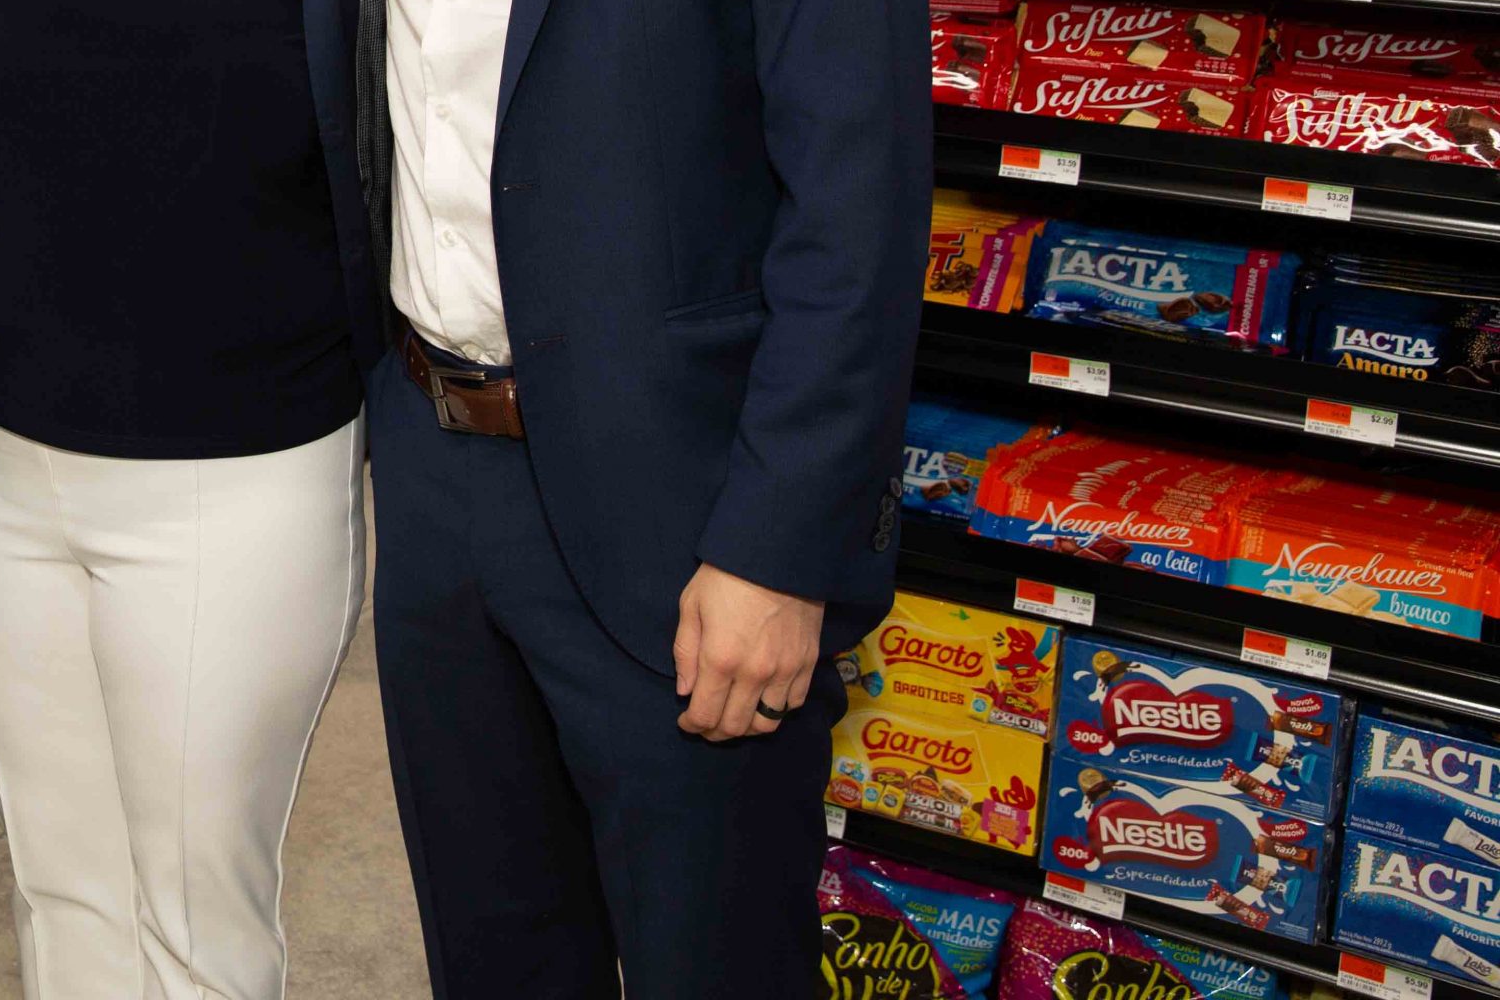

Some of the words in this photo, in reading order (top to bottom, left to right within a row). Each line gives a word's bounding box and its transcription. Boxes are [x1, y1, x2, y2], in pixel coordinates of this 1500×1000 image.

[1024, 6, 1174, 53] Suflair
[1295, 33, 1458, 63] Suflair
[1013, 77, 1167, 118] Suflair
[1264, 93, 1436, 148] Suflair
[1327, 192, 1349, 202] $3.29
[1047, 247, 1191, 295] LACTA
[1114, 296, 1146, 311] LEITE
[1333, 325, 1437, 361] LACTA
[1337, 352, 1428, 382] Amaro
[1371, 414, 1394, 426] $2.99
[1027, 501, 1191, 548] Neugebauer
[1140, 551, 1161, 567] ao
[1165, 549, 1198, 574] leite
[1262, 542, 1445, 590] Neugebauer
[1390, 593, 1451, 625] branco
[879, 624, 983, 671] Garoto
[1286, 703, 1321, 714] BOMBONS
[1290, 697, 1315, 707] NOVOS
[862, 718, 974, 766] Garoto
[1128, 750, 1224, 769] Especialidades
[1365, 727, 1500, 802] LACT
[1274, 822, 1299, 832] NOVOS
[1113, 866, 1209, 888] Especialidades
[937, 909, 1000, 938] MAIS
[927, 928, 996, 950] unidades
[1172, 952, 1200, 966] COM
[1202, 951, 1271, 983] MAIS
[1463, 954, 1493, 977] Laka
[1190, 969, 1267, 998] unidades
[1404, 975, 1429, 989] $5.99
